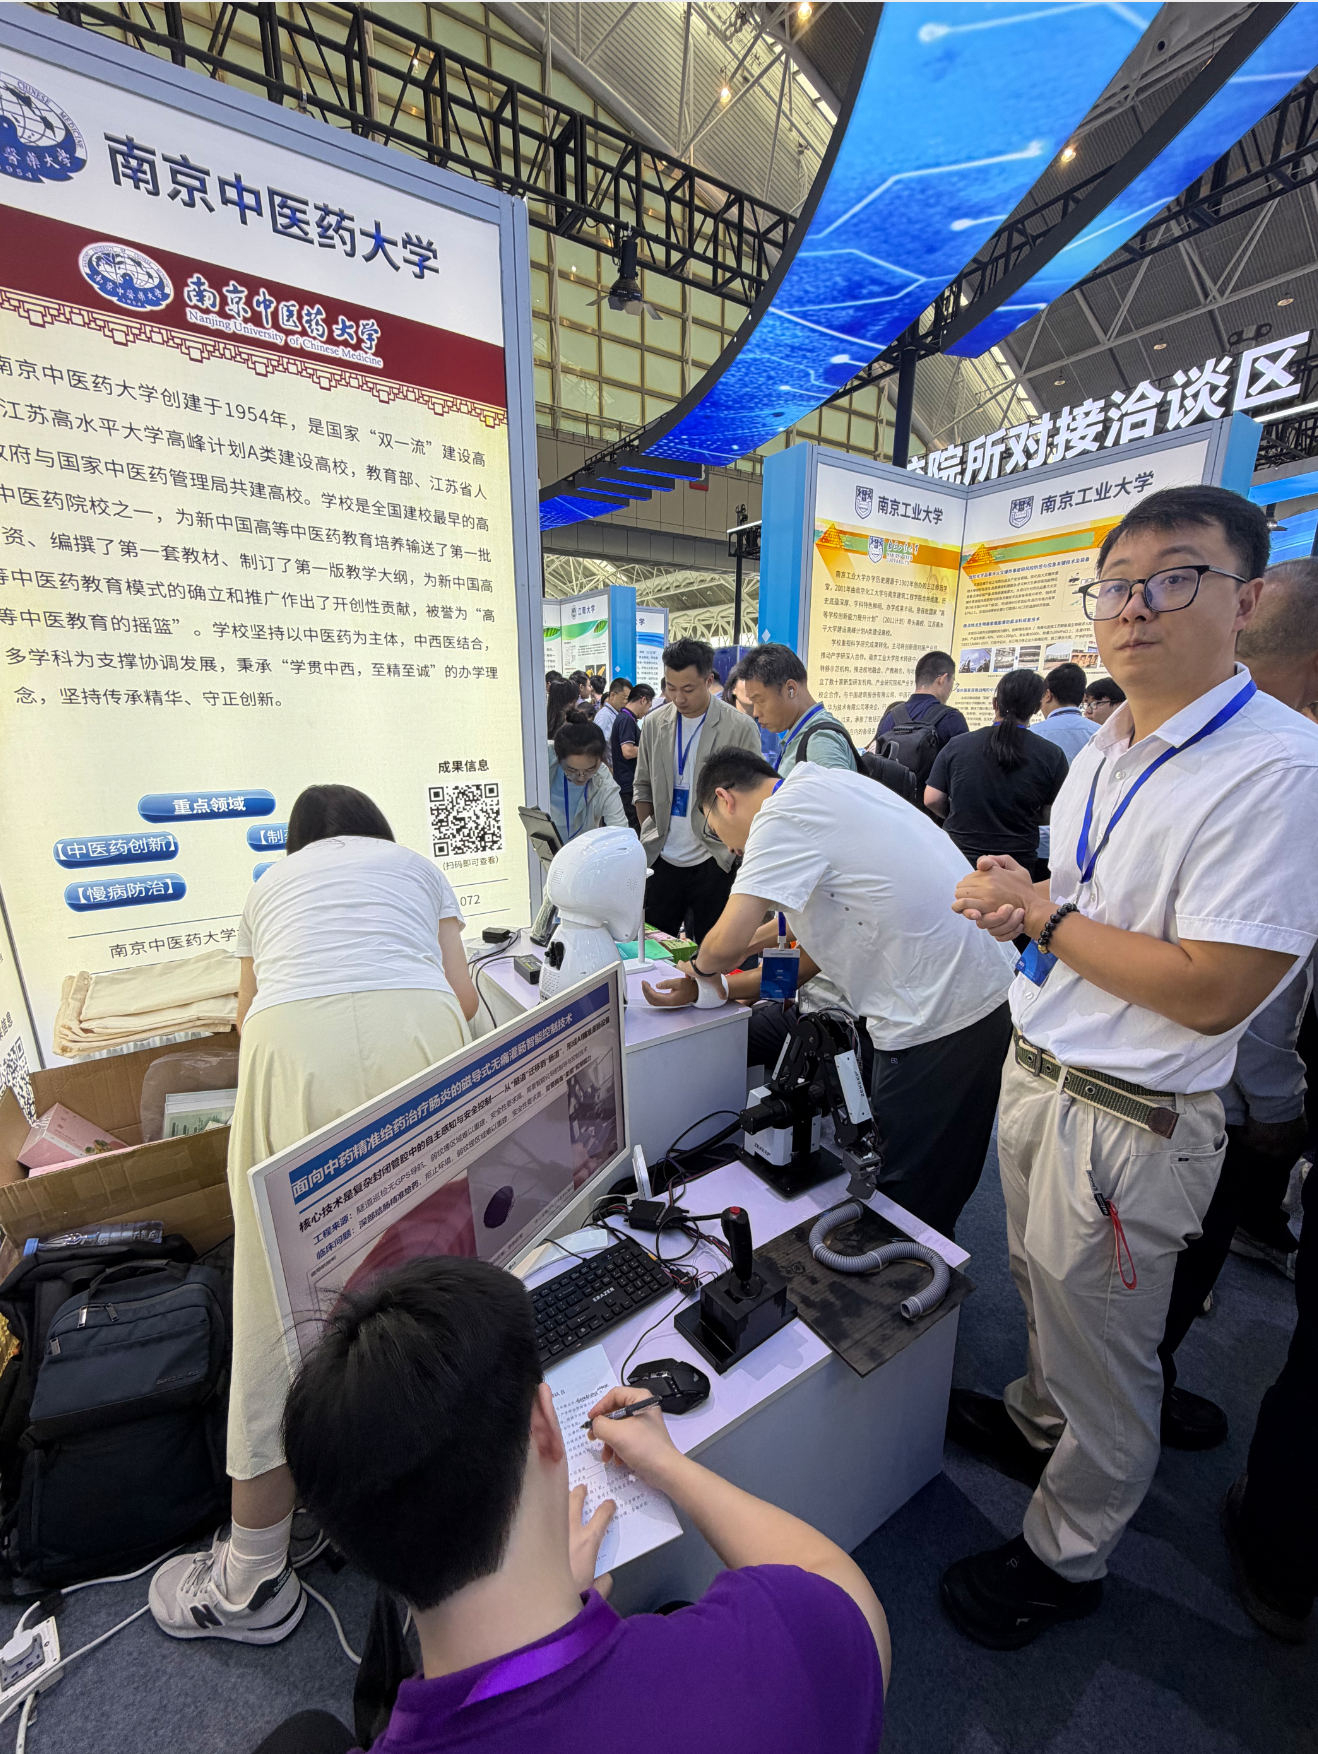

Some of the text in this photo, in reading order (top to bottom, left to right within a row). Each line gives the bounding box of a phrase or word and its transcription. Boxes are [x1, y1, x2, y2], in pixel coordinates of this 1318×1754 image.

[104, 132, 440, 279] 南京中医药大学
[186, 276, 380, 350] 南京中医药大学
[188, 309, 382, 367] Nanjing University of Chinese Medicine
[1040, 471, 1155, 515] 南京工业大学
[878, 495, 944, 525] 南京工业大学
[14, 686, 282, 707] 念，坚持传承精华、守正创新。
[438, 759, 490, 774] 成果信息
[172, 796, 246, 815] 重点领域
[57, 835, 176, 860] 【中医药创新】
[78, 879, 174, 904] 【慢病防治】
[460, 894, 481, 907] 072
[109, 928, 241, 959] 南京中医药大学
